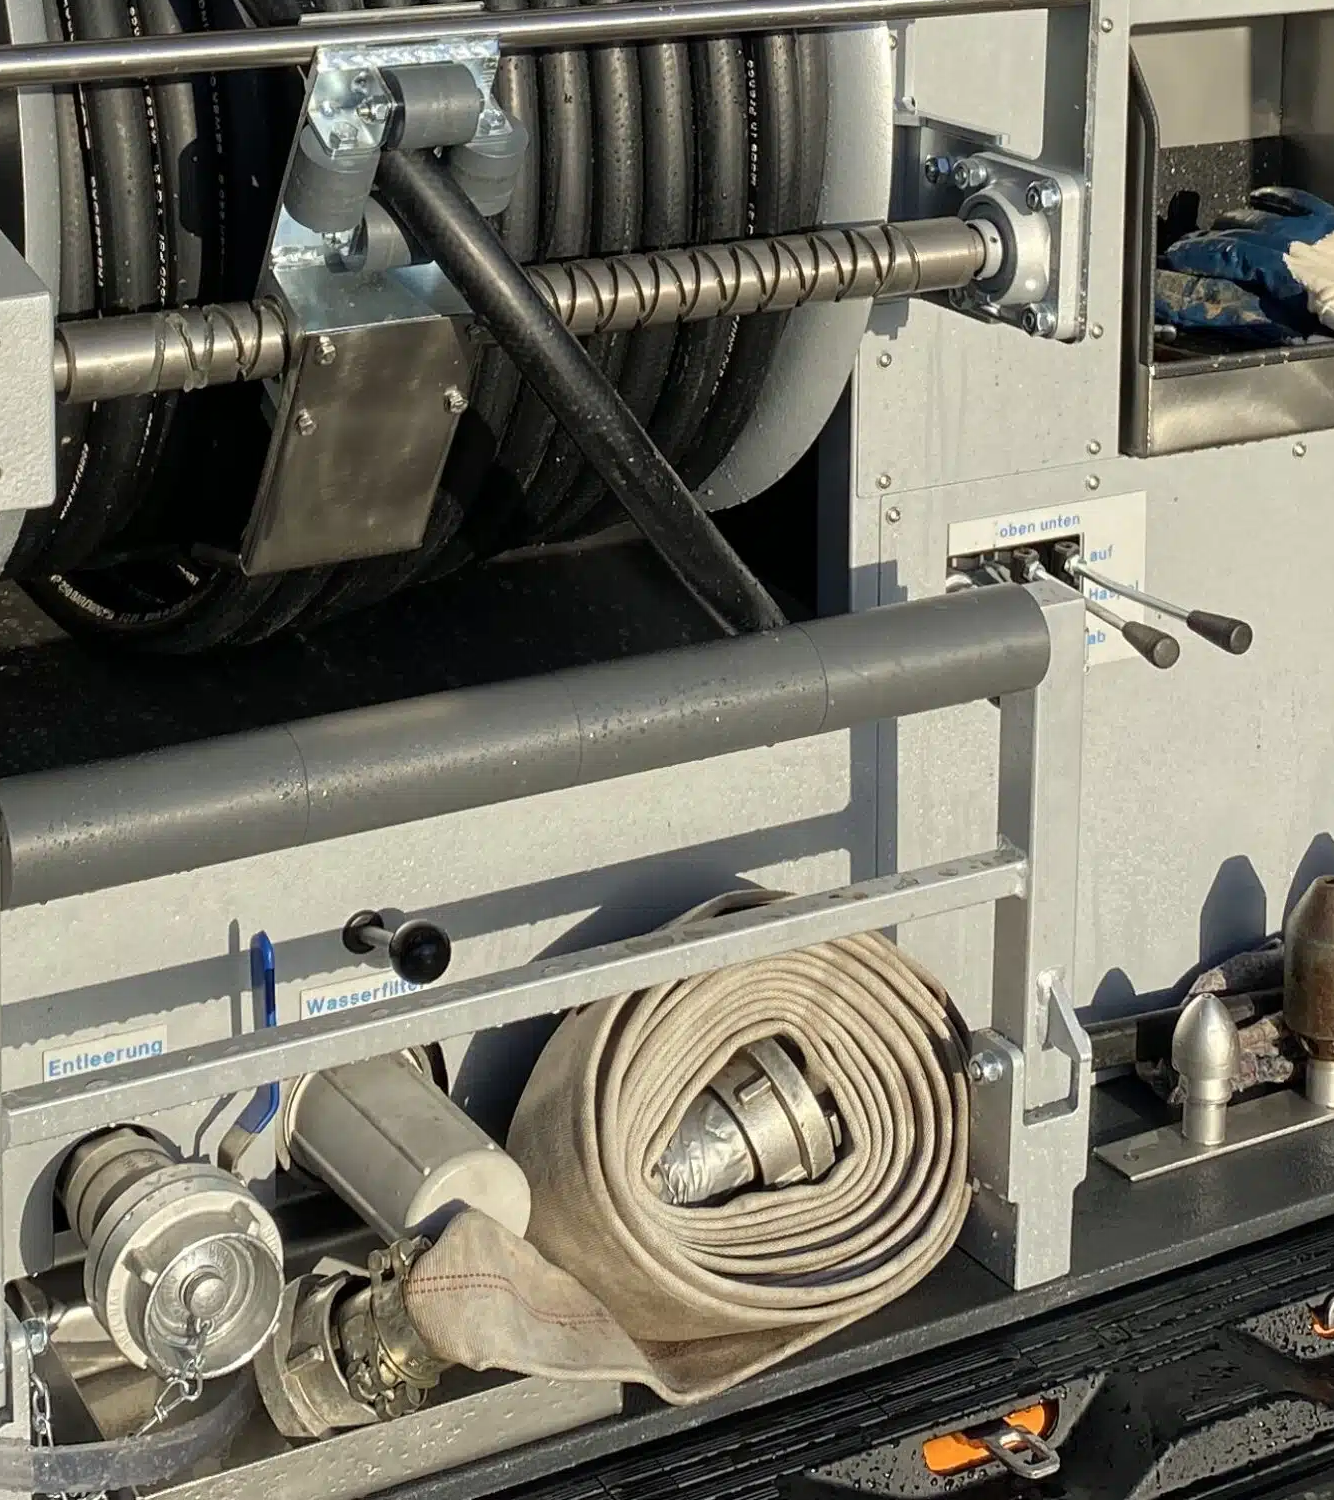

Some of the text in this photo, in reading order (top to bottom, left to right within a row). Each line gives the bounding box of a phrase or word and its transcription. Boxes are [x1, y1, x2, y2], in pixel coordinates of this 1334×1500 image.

[999, 513, 1080, 538] oben unten
[1089, 544, 1114, 562] auf
[1087, 630, 1106, 645] ab
[48, 1037, 163, 1077] Entleerung
